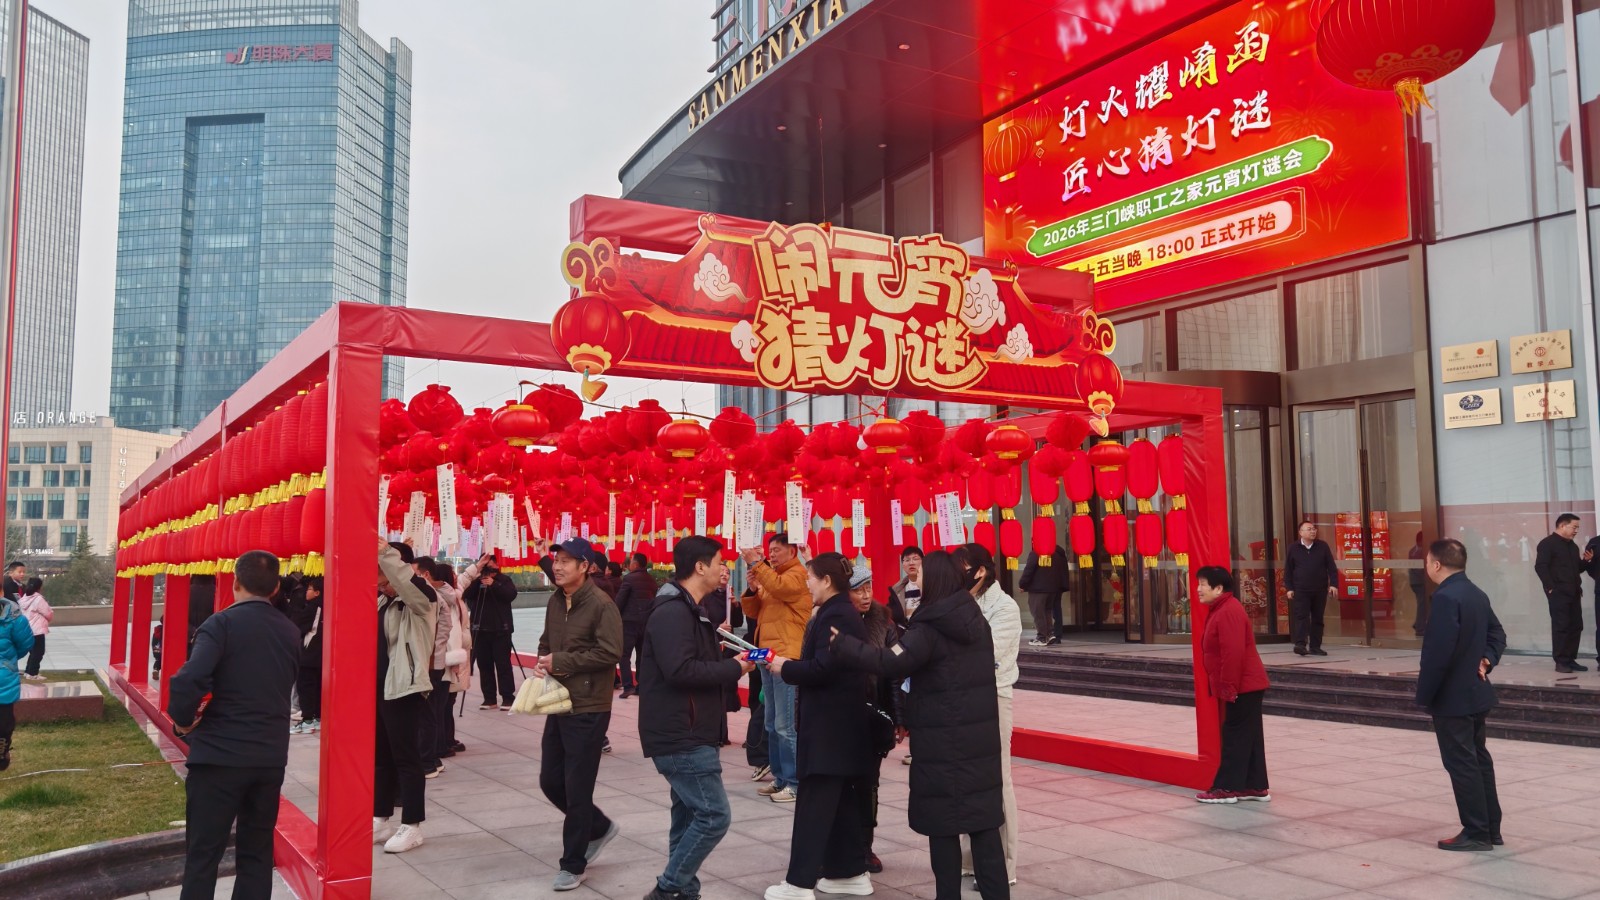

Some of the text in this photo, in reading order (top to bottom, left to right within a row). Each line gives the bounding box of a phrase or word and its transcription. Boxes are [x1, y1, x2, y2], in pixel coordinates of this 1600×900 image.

[251, 43, 333, 63] 明珠大厦
[687, 0, 846, 133] SANMENXIA
[1059, 21, 1270, 144] 灯火耀崤函
[1061, 89, 1272, 202] 匠心猜灯谜
[1043, 149, 1304, 248] 2026年三门峡职工之家元宵灯谜会
[1147, 236, 1195, 262] 18:00
[1200, 211, 1277, 249] 正式开始
[756, 222, 968, 316] 闹元宵
[756, 304, 987, 388] 猜灯谜
[13, 411, 97, 424] 店 ORANGE
